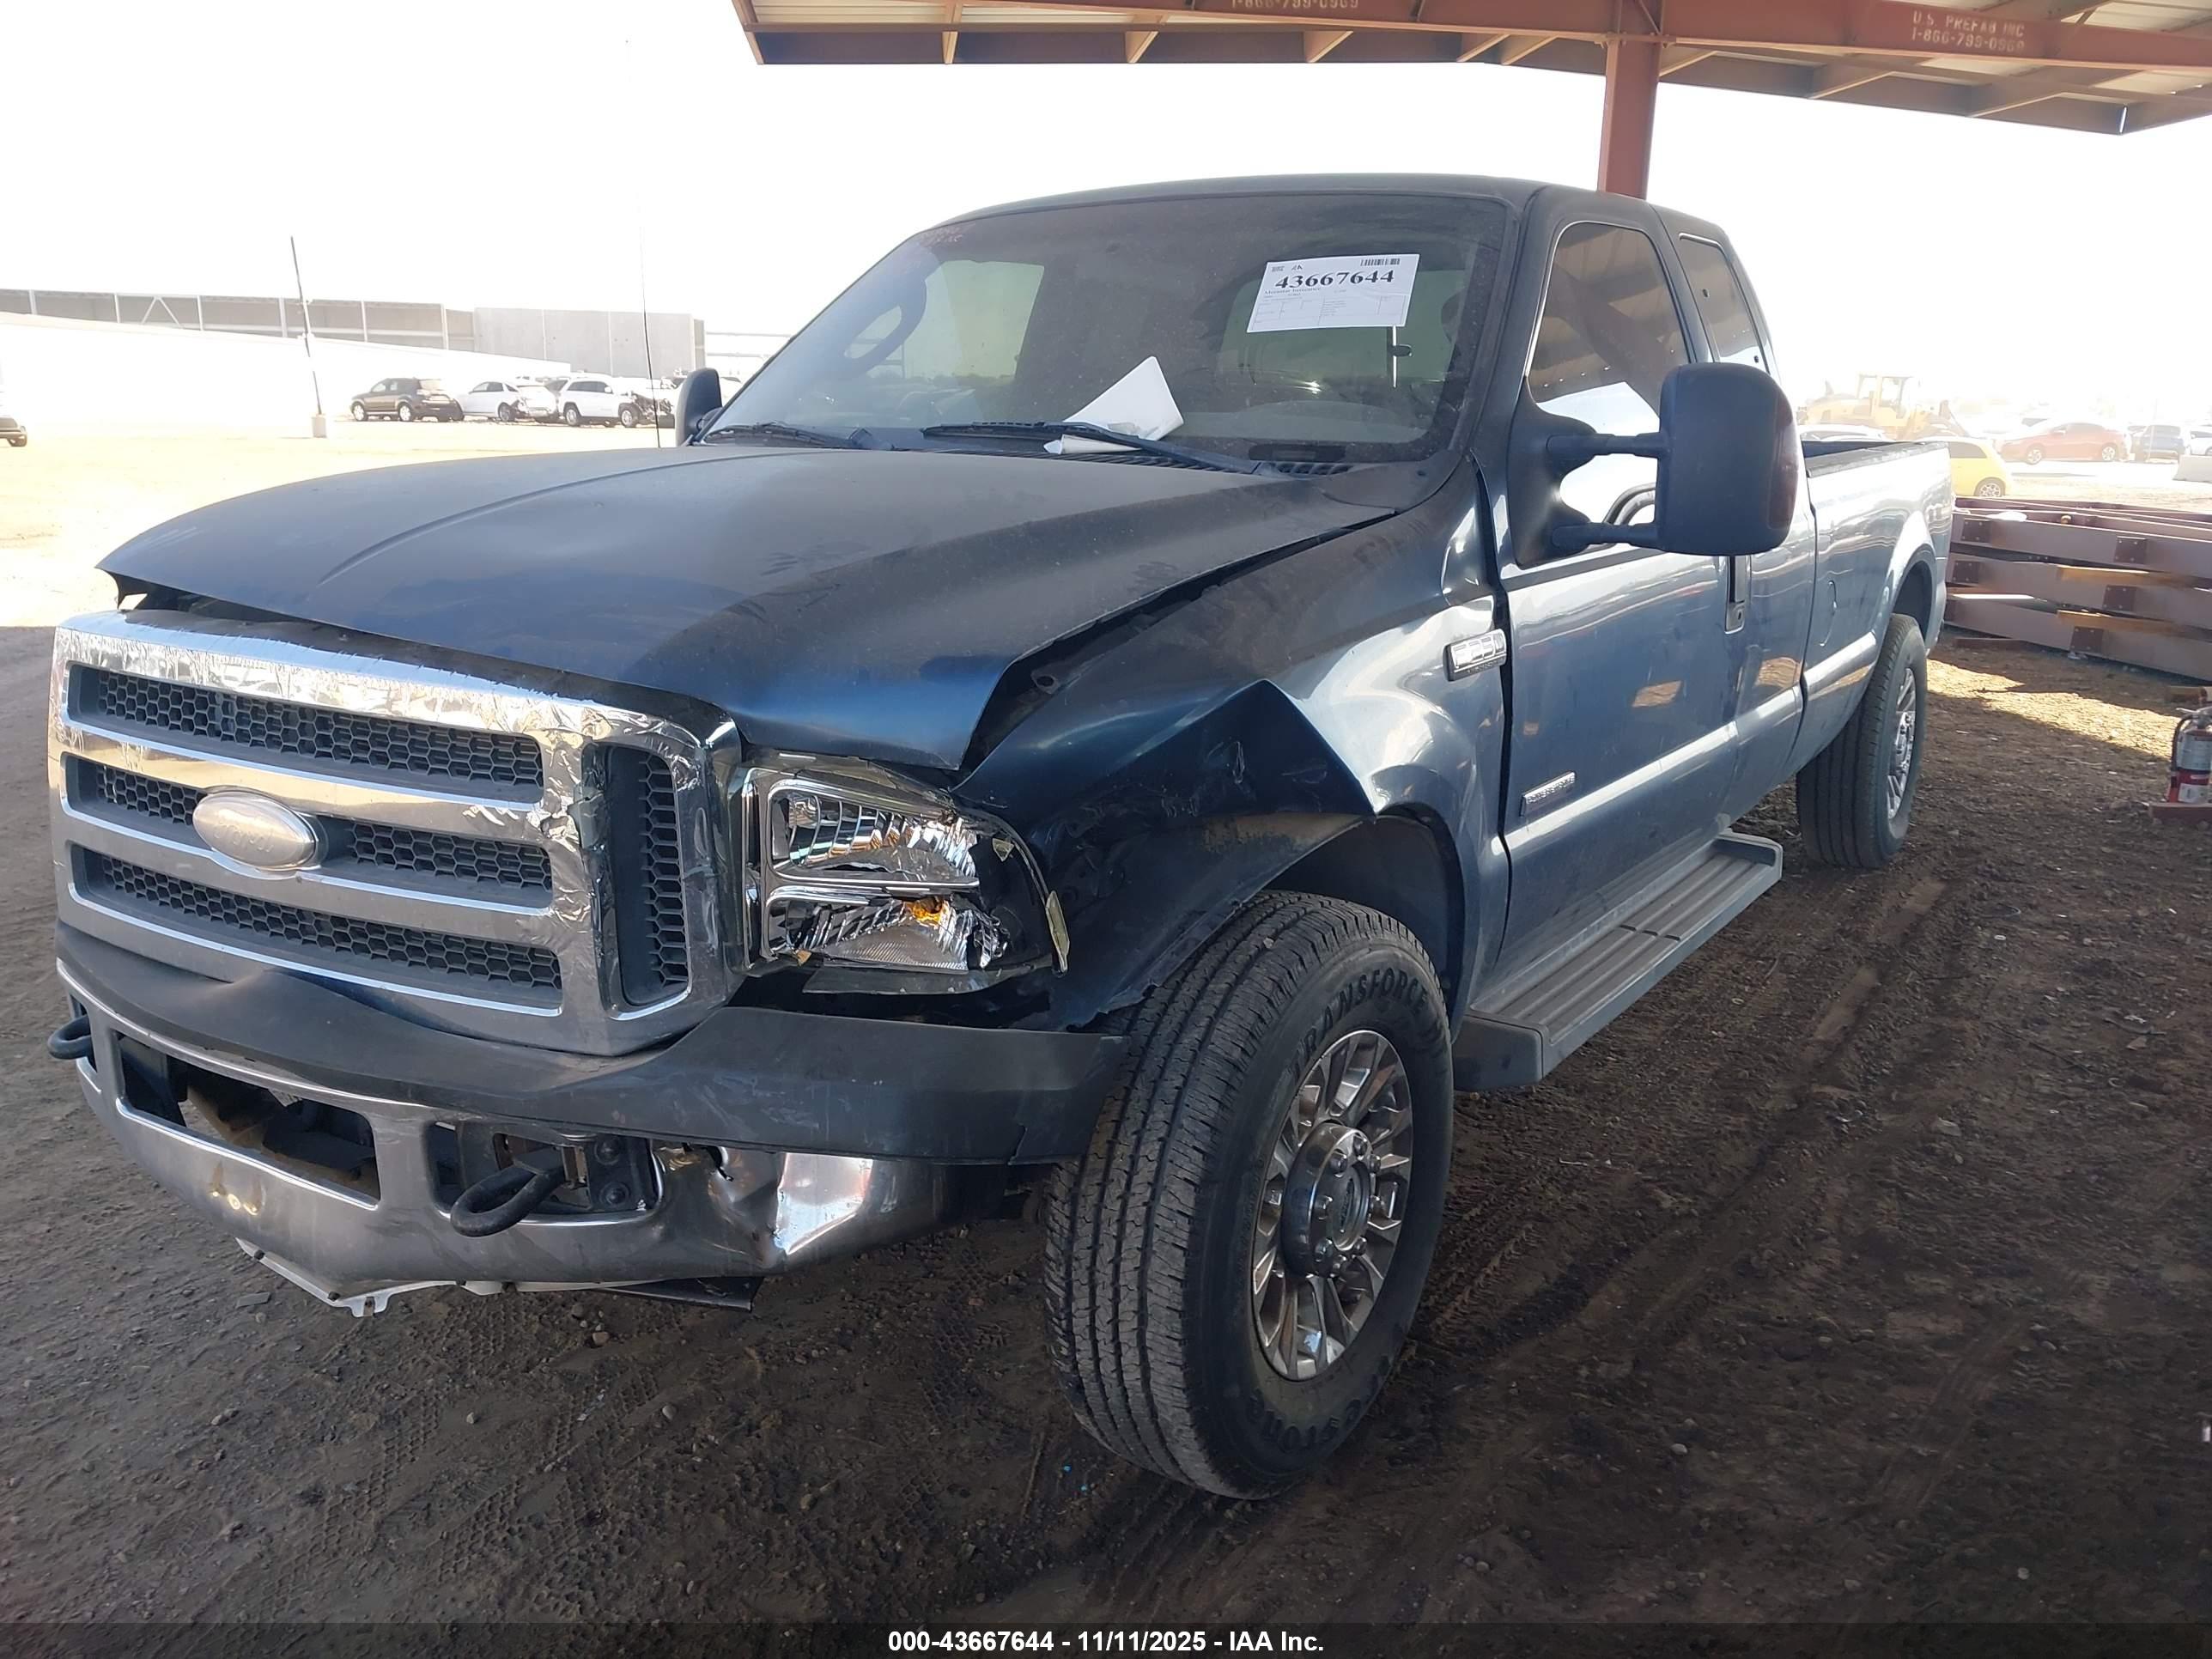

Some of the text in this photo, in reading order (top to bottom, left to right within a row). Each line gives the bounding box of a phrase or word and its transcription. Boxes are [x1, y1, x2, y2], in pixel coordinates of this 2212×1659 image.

[1945, 15, 1996, 34] PREFAB
[2003, 21, 2026, 38] INC
[1275, 270, 1395, 289] 43667644
